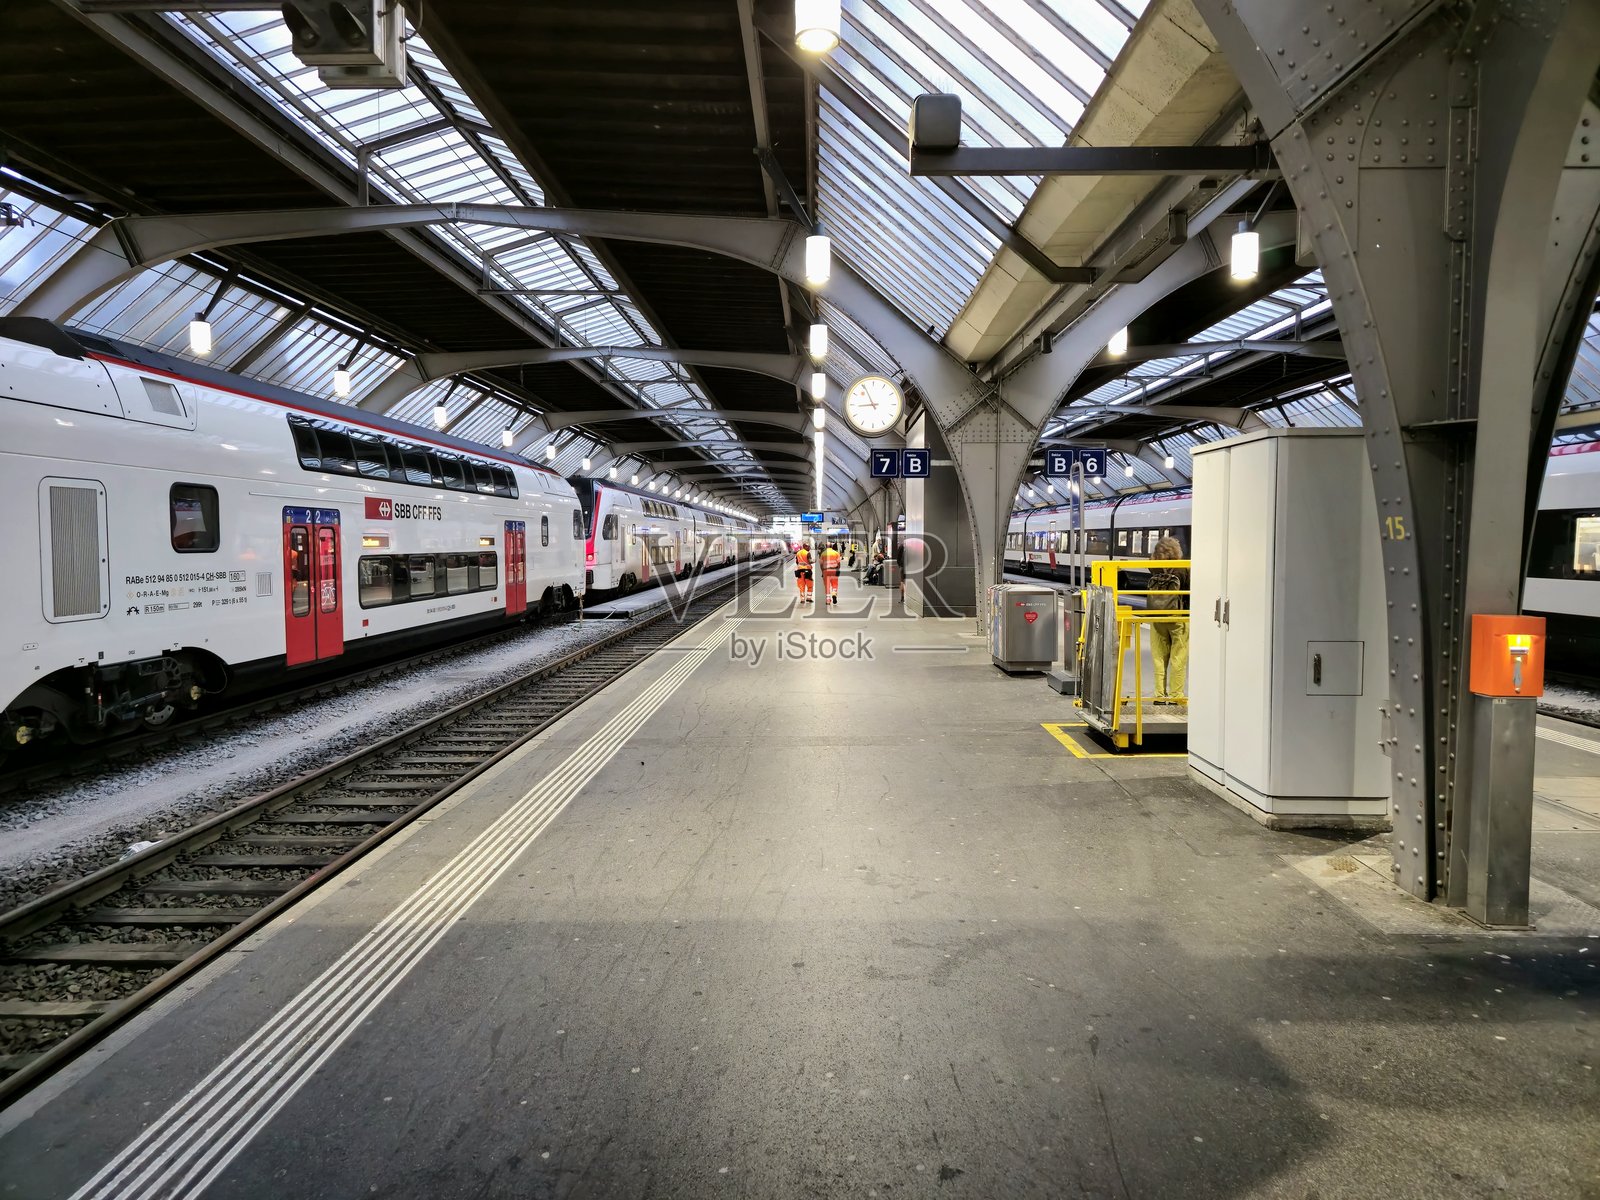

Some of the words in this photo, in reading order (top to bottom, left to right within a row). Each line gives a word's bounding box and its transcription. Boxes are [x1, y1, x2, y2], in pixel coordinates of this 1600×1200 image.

[880, 458, 891, 473] 7
[910, 458, 921, 473] B
[1054, 457, 1067, 472] B
[1086, 457, 1098, 473] 6
[305, 509, 312, 523] 2
[315, 510, 321, 523] 2
[394, 502, 411, 519] SBB
[412, 504, 427, 520] CFF
[428, 506, 442, 521] FFS
[1385, 516, 1405, 540] 15
[125, 576, 144, 585] RABe
[145, 575, 157, 584] 512
[157, 574, 165, 583] 94
[165, 574, 173, 583] 85
[174, 574, 178, 582] 0
[179, 573, 189, 582] 512
[189, 572, 205, 581] 015-4
[205, 571, 227, 581] CH-SBB
